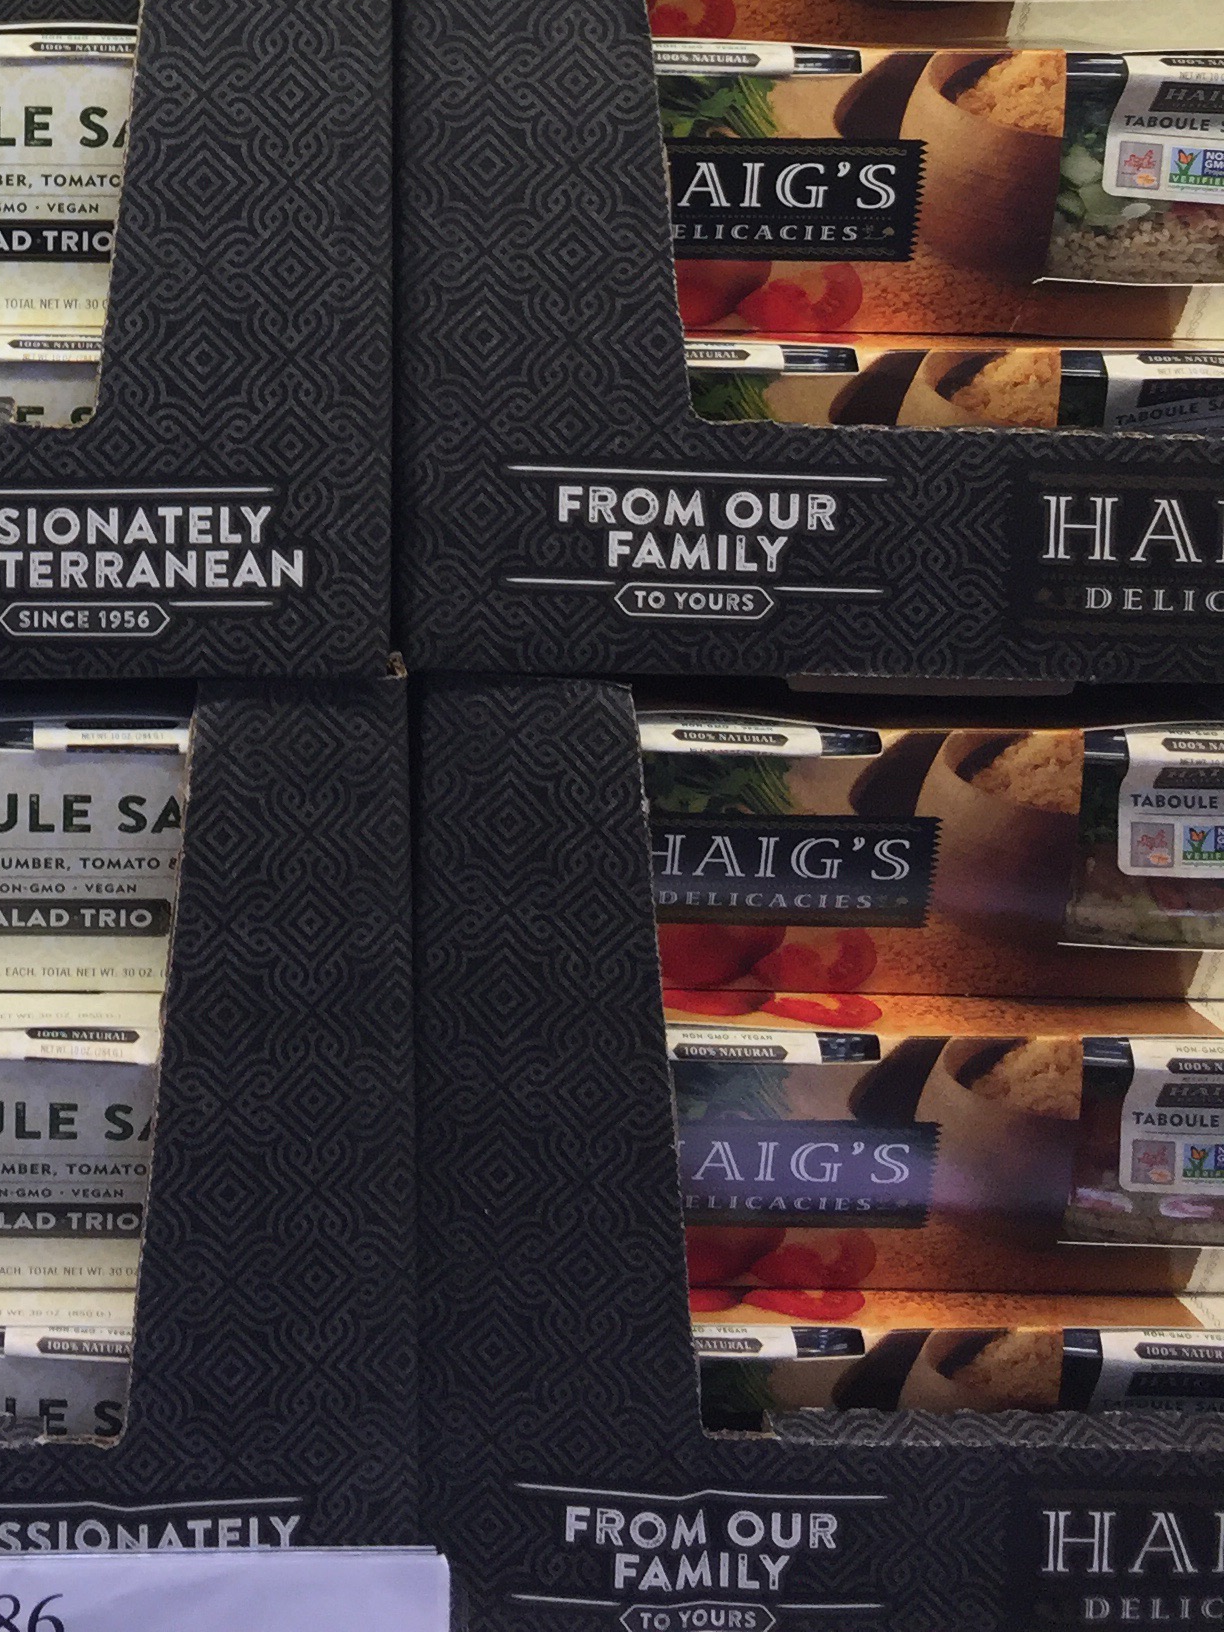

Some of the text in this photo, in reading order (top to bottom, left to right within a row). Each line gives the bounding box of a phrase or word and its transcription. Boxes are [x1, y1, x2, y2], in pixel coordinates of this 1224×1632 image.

[656, 52, 750, 64] 100% NATURAL
[1124, 114, 1211, 132] TABOULE
[669, 160, 897, 210] AIG'S
[46, 202, 100, 215] VEGAN
[41, 229, 114, 253] TRIO
[4, 298, 35, 310] TOTAL
[39, 298, 60, 310] NET
[557, 485, 838, 532] FROM OUR
[608, 530, 789, 573] FAMILY
[634, 590, 755, 613] TO YOURS
[17, 609, 150, 630] SINCE 1956
[718, 733, 777, 744] NATURAL
[1130, 793, 1219, 809] TABOULE
[78, 856, 161, 870] TOMATO
[84, 883, 137, 895] VEGAN
[658, 891, 874, 910] DELICACIES
[80, 907, 154, 929] TRIO
[71, 1030, 128, 1041] NATURAL
[684, 1046, 777, 1057] 100% NATURAL
[1178, 1061, 1211, 1071] 100%
[1132, 1111, 1220, 1128] TABOULE
[66, 1163, 147, 1176] TOMATO
[71, 1187, 124, 1199] VEGAN
[66, 1211, 139, 1231] TRIO
[1146, 1346, 1178, 1356] 100%
[564, 1506, 838, 1550] FROM OUR
[613, 1552, 791, 1592] FAMILY
[638, 1608, 758, 1631] TO YOURS
